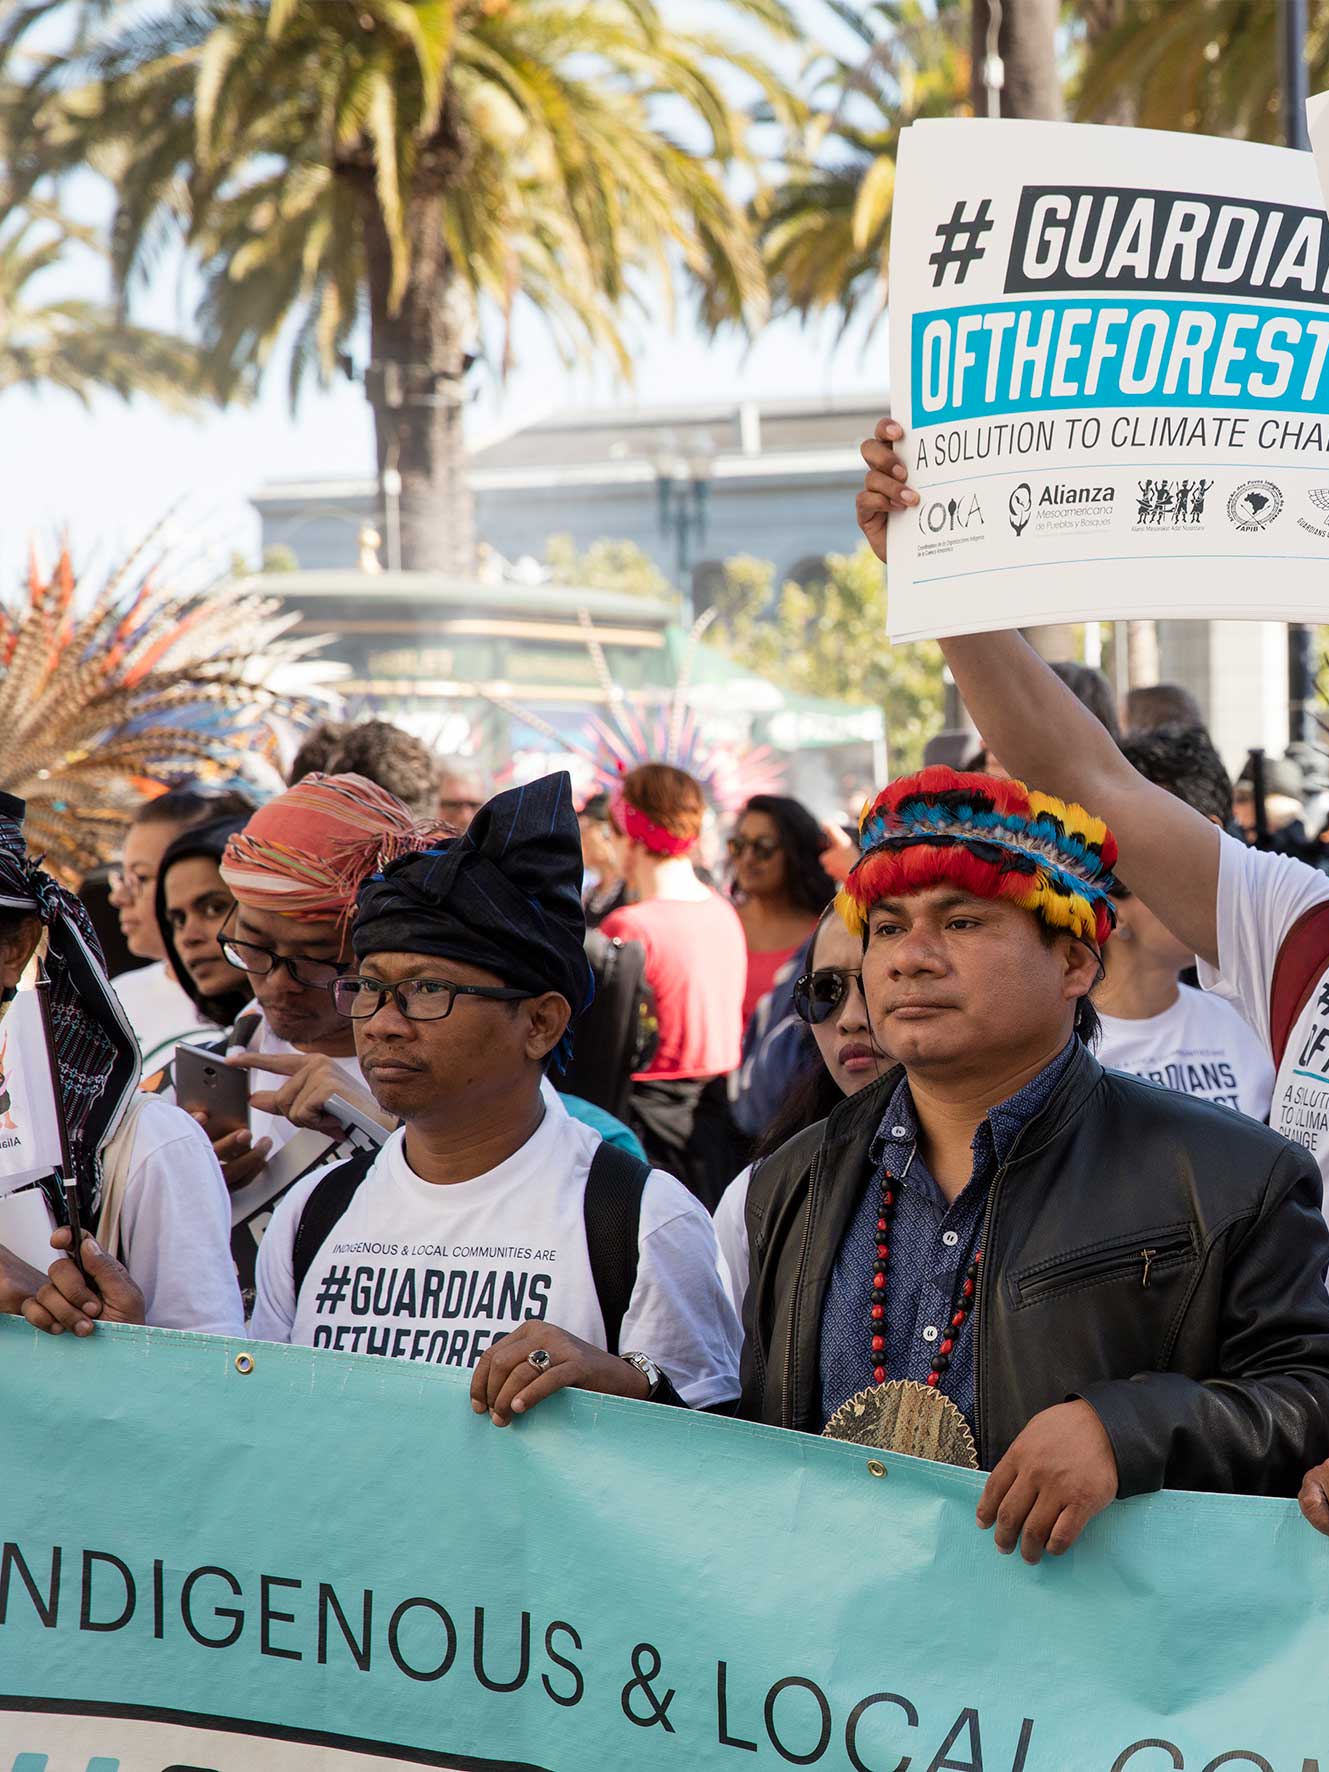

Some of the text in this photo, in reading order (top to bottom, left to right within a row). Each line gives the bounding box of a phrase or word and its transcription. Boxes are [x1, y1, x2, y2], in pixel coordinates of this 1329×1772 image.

[929, 199, 995, 287] #
[916, 439, 929, 469] A
[934, 419, 1056, 467] SOLUTION
[1064, 417, 1101, 448] TO
[1111, 415, 1249, 448] CLIMATE
[1039, 484, 1115, 506] Alianza
[1283, 1085, 1293, 1103] A
[1281, 1105, 1294, 1124] TO
[332, 1241, 556, 1262] INDIGENOUS & LOCAL COMMUNITIES ARE
[315, 1265, 552, 1321] #GUARDIANS
[620, 1642, 676, 1733] &
